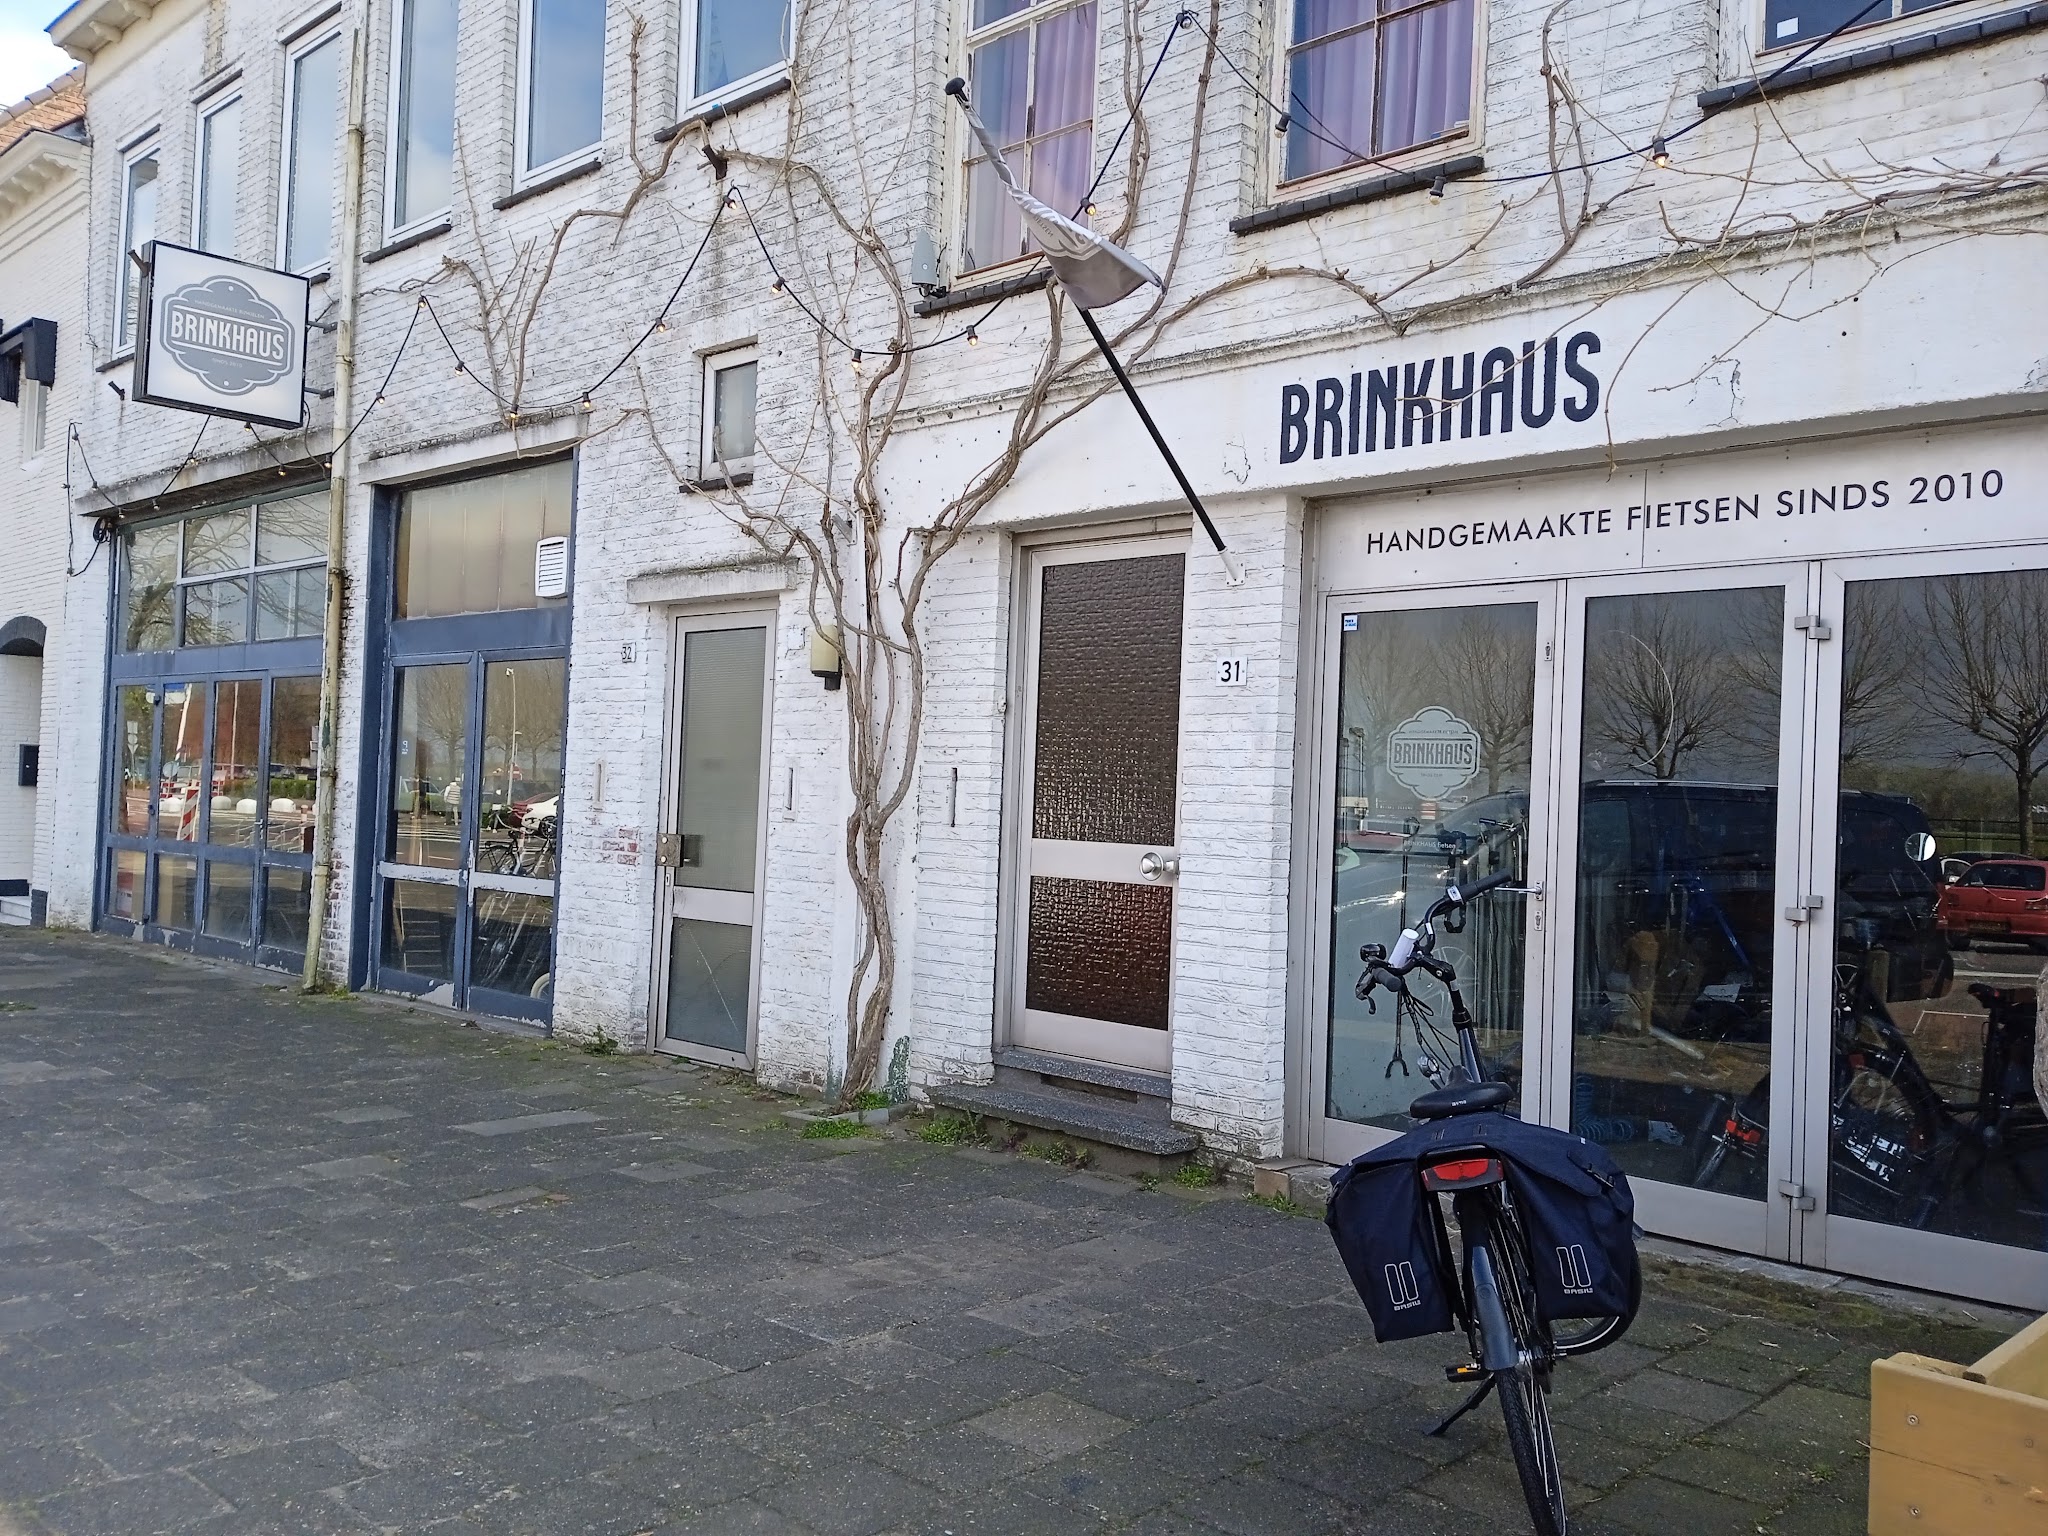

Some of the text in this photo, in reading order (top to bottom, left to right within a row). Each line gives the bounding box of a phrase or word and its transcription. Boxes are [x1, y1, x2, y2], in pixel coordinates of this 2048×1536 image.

[170, 310, 285, 360] BRINKHAUS
[1279, 331, 1601, 465] BRINKHAUS
[1366, 468, 2005, 555] HANDGEMAAKTE FIETSEN SINDS 2010
[1220, 660, 1240, 682] 31
[1393, 742, 1473, 765] BRINKHAUS
